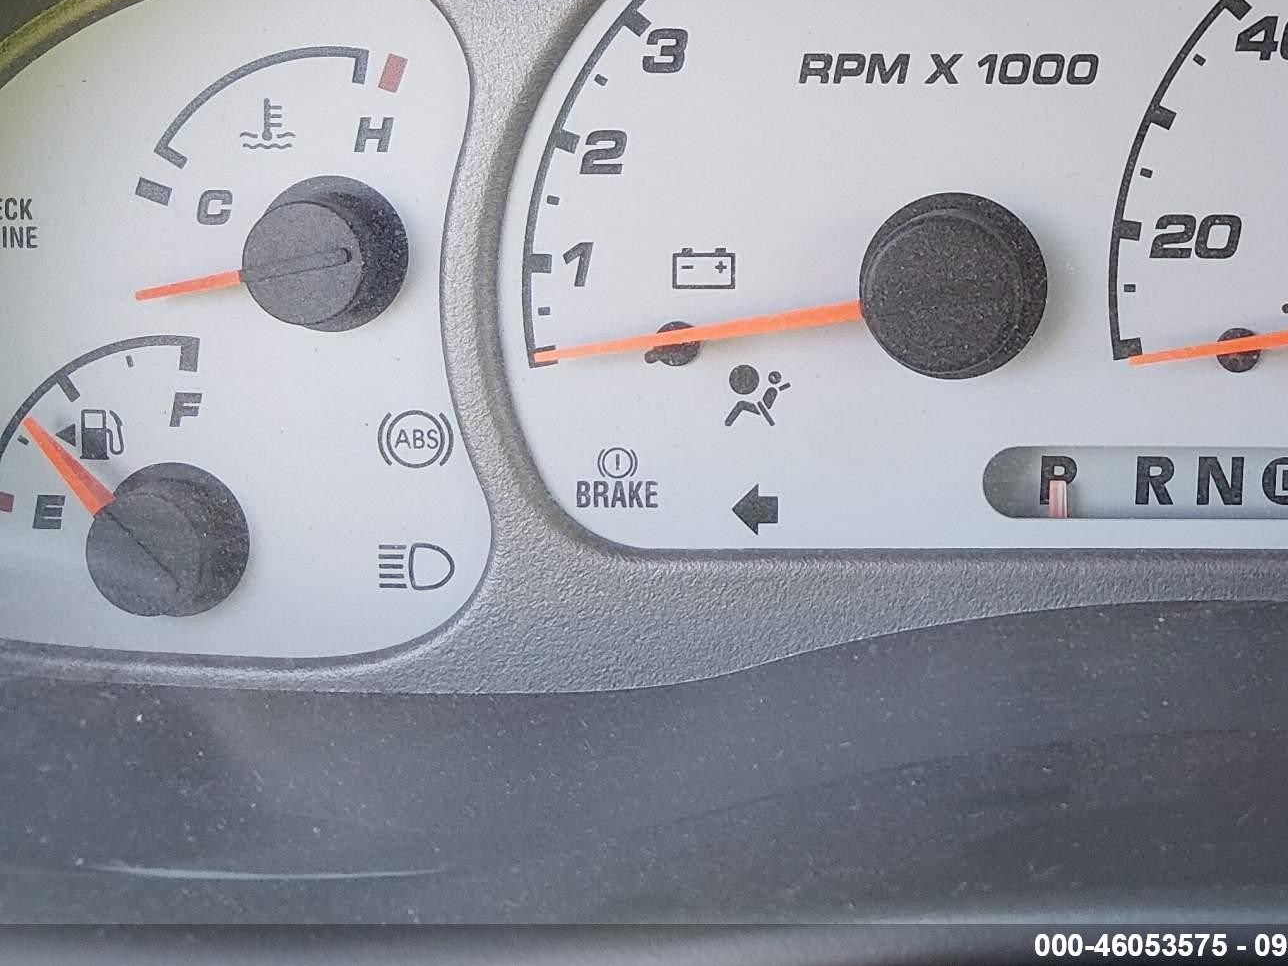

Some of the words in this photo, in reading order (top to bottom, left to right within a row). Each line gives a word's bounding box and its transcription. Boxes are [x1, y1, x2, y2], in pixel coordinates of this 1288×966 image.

[641, 27, 689, 74] 3
[799, 54, 910, 84] RPM
[924, 53, 959, 84] X
[978, 54, 1099, 85] 1000
[354, 117, 393, 152] H
[579, 129, 628, 175] 2
[197, 190, 232, 225] C
[1149, 215, 1242, 259] 20
[563, 242, 593, 287] 1
[170, 392, 202, 427] F
[394, 428, 439, 450] ABS
[576, 480, 659, 508] BRAKE
[1039, 455, 1078, 505] P
[1135, 456, 1174, 505] R
[1197, 457, 1244, 505] N
[32, 495, 65, 529] E
